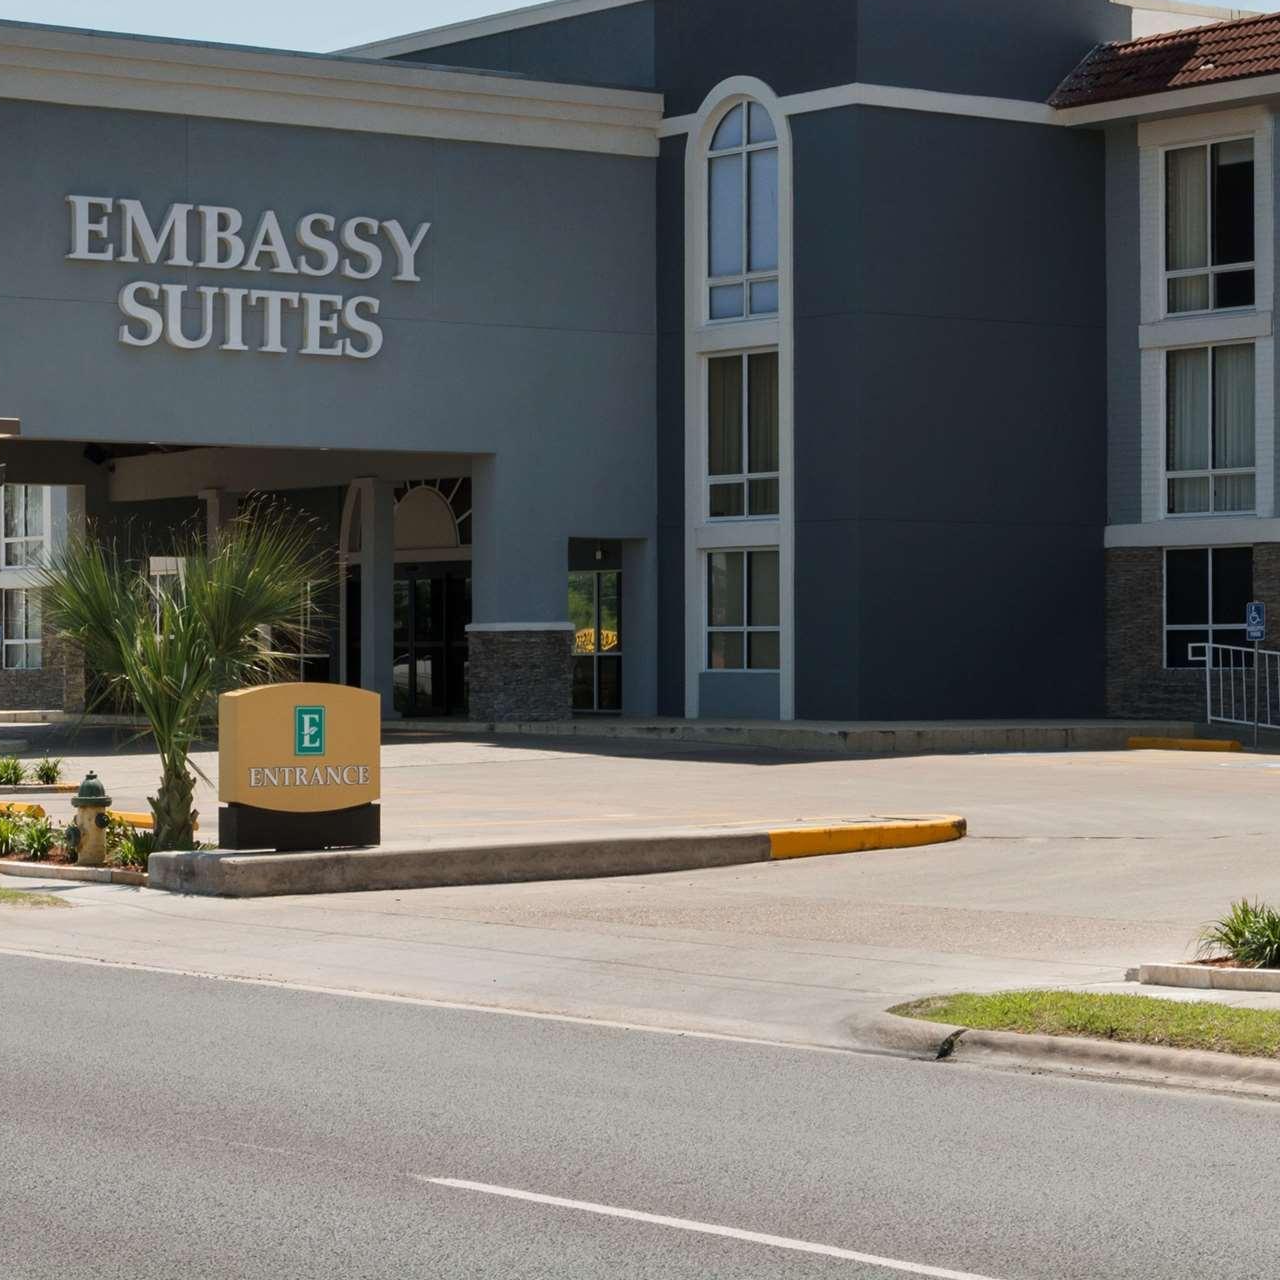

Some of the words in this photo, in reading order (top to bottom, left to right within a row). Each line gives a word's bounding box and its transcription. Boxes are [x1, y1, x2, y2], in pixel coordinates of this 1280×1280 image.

[65, 195, 432, 282] EMBASSY
[119, 281, 384, 359] SUITES
[301, 714, 320, 747] E
[249, 766, 370, 787] ENTRANCE
